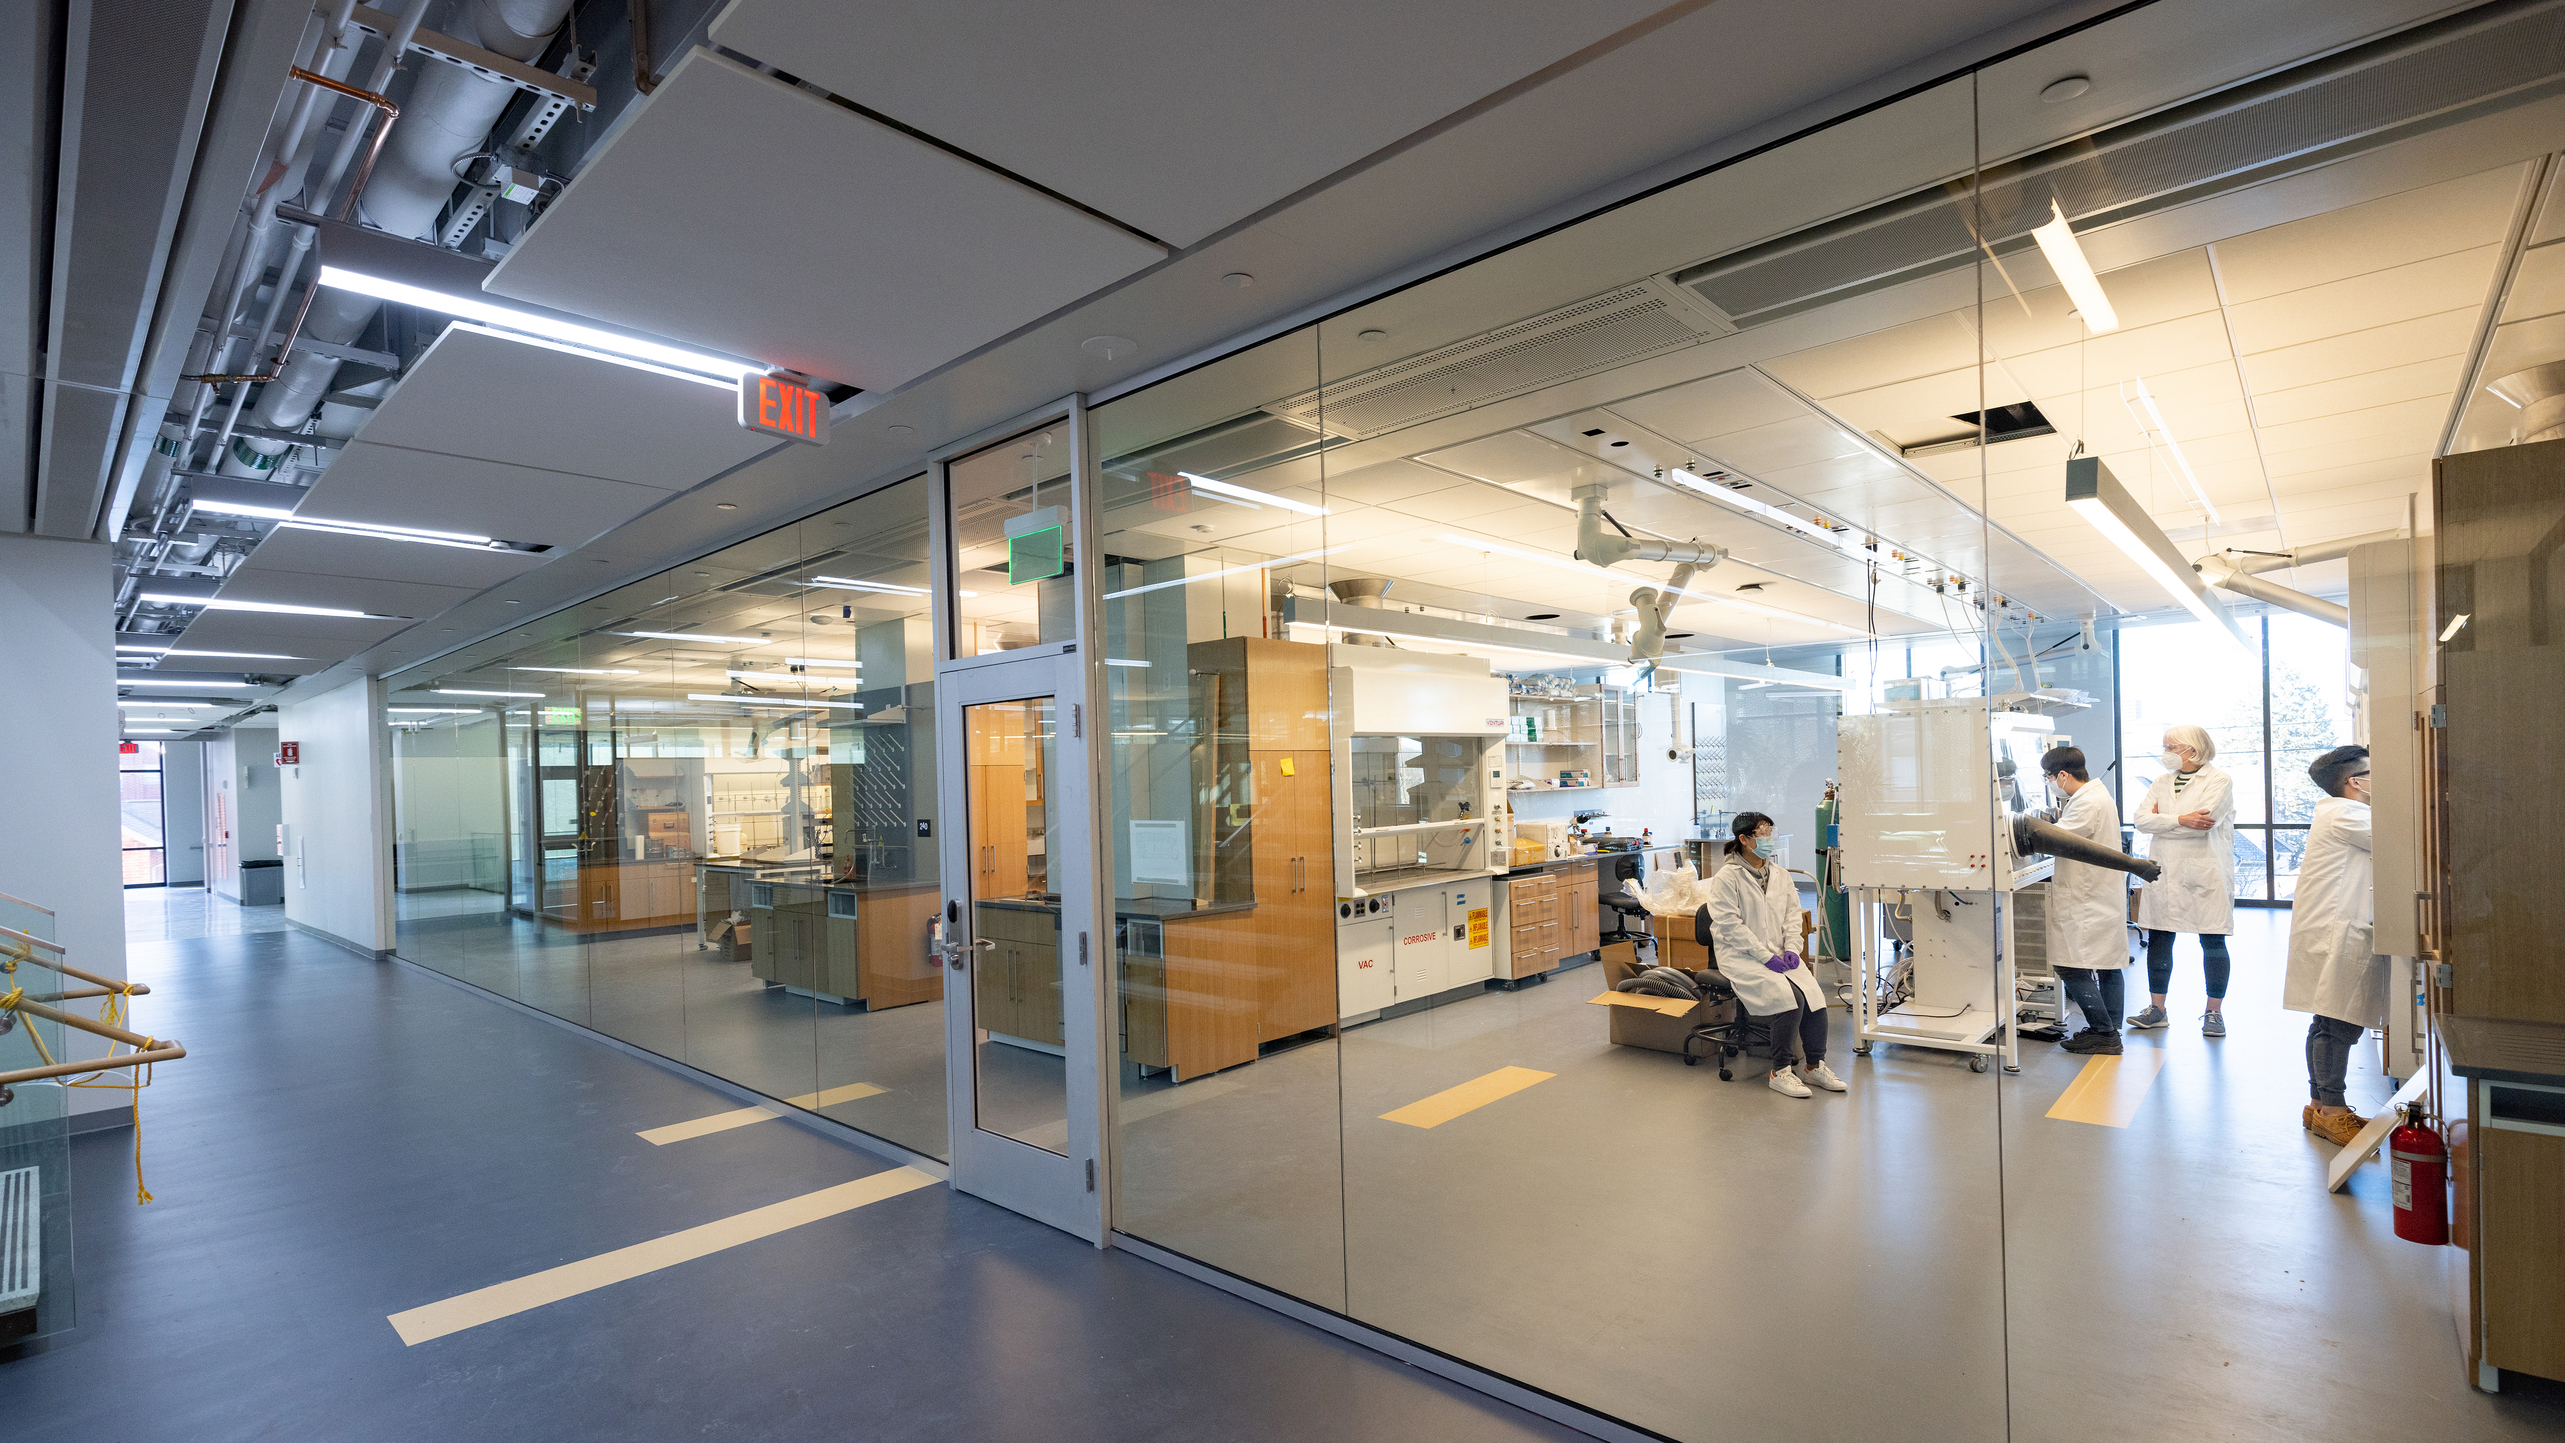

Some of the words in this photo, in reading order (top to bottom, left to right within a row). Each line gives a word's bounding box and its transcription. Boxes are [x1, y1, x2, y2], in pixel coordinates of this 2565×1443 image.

[759, 376, 820, 438] EXIT
[120, 744, 136, 753] EXIT
[1403, 932, 1436, 945] CORROSIVE
[1358, 959, 1374, 969] VAC
